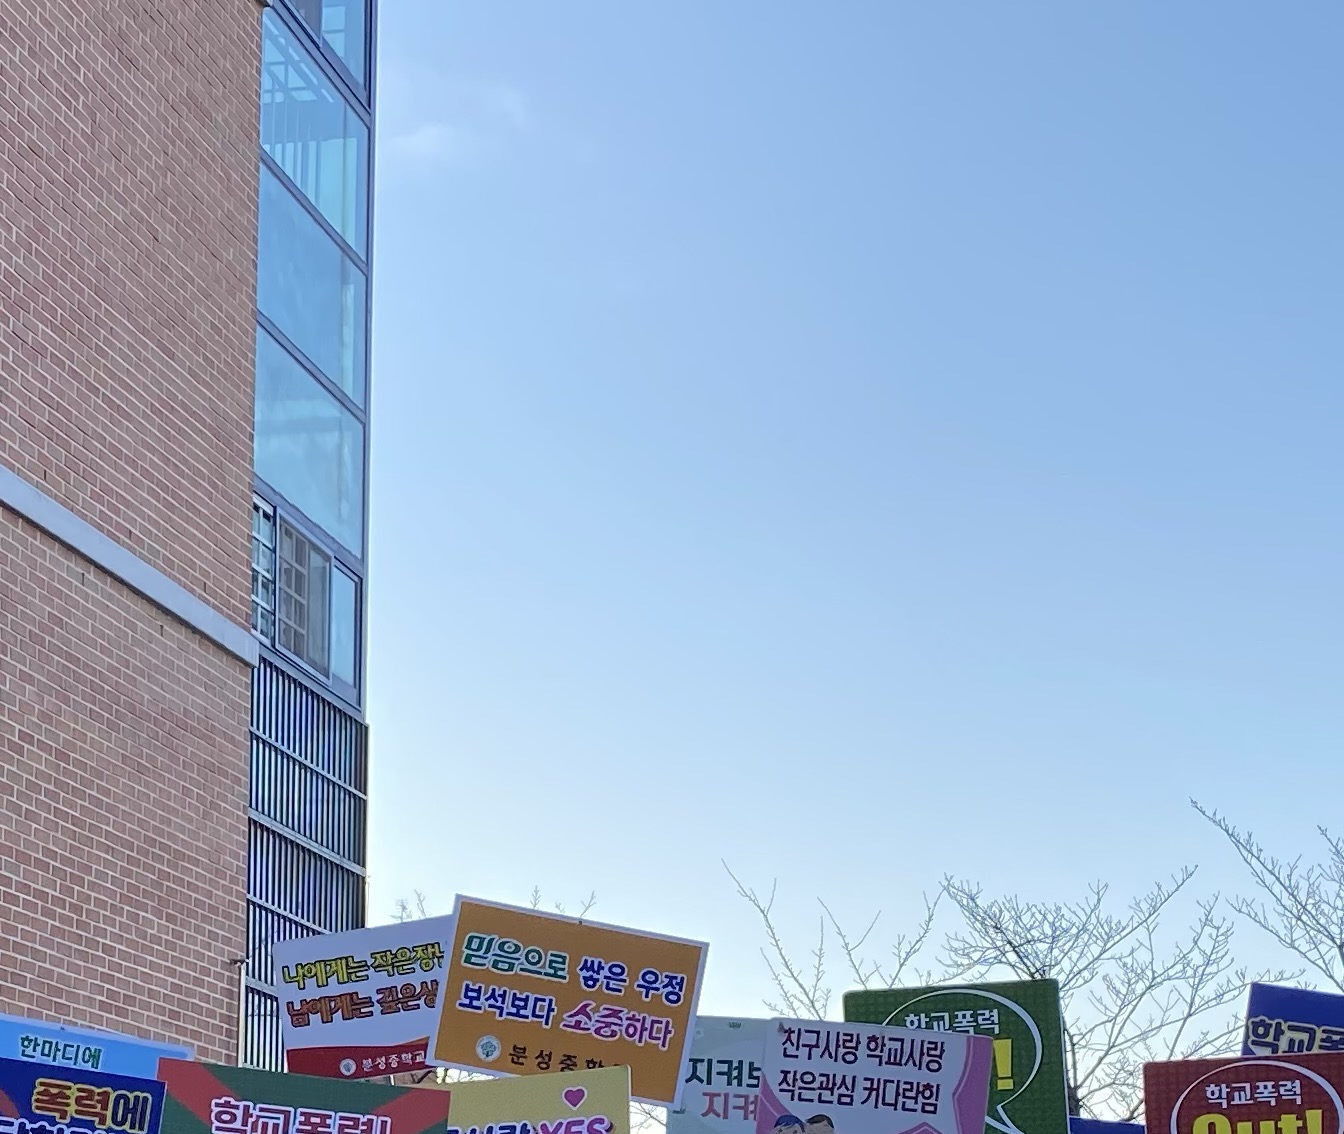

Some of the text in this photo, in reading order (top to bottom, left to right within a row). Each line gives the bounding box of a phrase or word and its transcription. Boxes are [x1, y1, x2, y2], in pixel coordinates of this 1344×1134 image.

[282, 955, 369, 990] 나에게는
[460, 932, 686, 1005] 믿음으로 쌓은 우정
[287, 991, 374, 1028] 남에게는
[457, 981, 675, 1050] 보석보다 소중하다
[19, 1034, 102, 1070] 한마디에
[361, 1051, 425, 1072] 분성중학교
[509, 1044, 606, 1070] 분성중학
[781, 1025, 947, 1072] 친구사랑 학교사랑
[31, 1077, 151, 1133] 폭력에
[777, 1068, 942, 1114] 작은관심 커다란힘
[1204, 1079, 1302, 1107] 학교폭력
